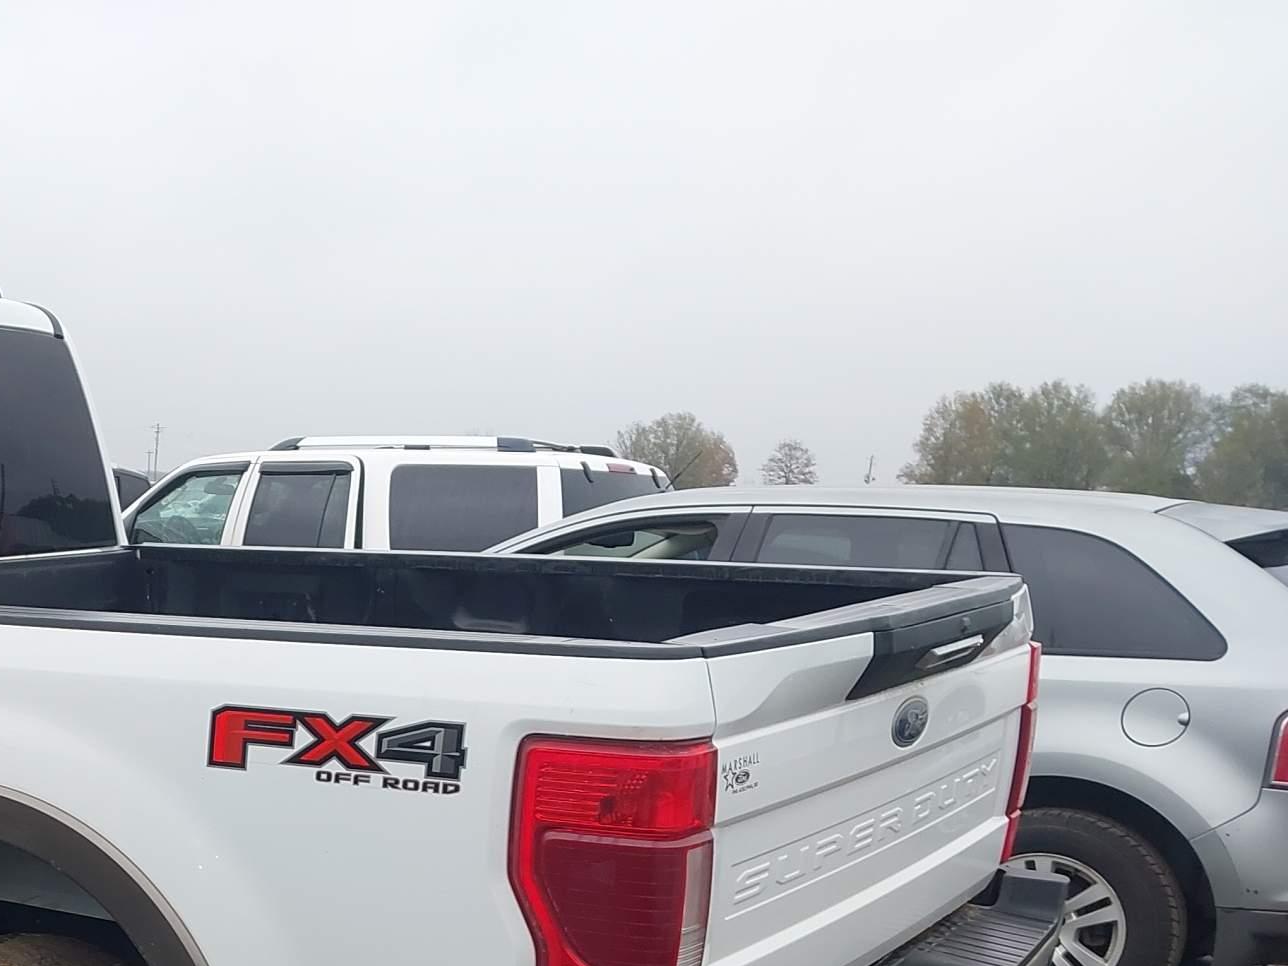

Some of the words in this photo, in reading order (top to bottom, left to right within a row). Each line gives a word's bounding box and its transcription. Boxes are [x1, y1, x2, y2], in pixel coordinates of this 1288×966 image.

[206, 703, 468, 781] FX4
[721, 752, 760, 774] MARSHALL
[315, 770, 372, 787] OFF
[382, 776, 461, 795] ROAD
[732, 805, 905, 906] SUPER
[912, 758, 998, 827] DUTY
